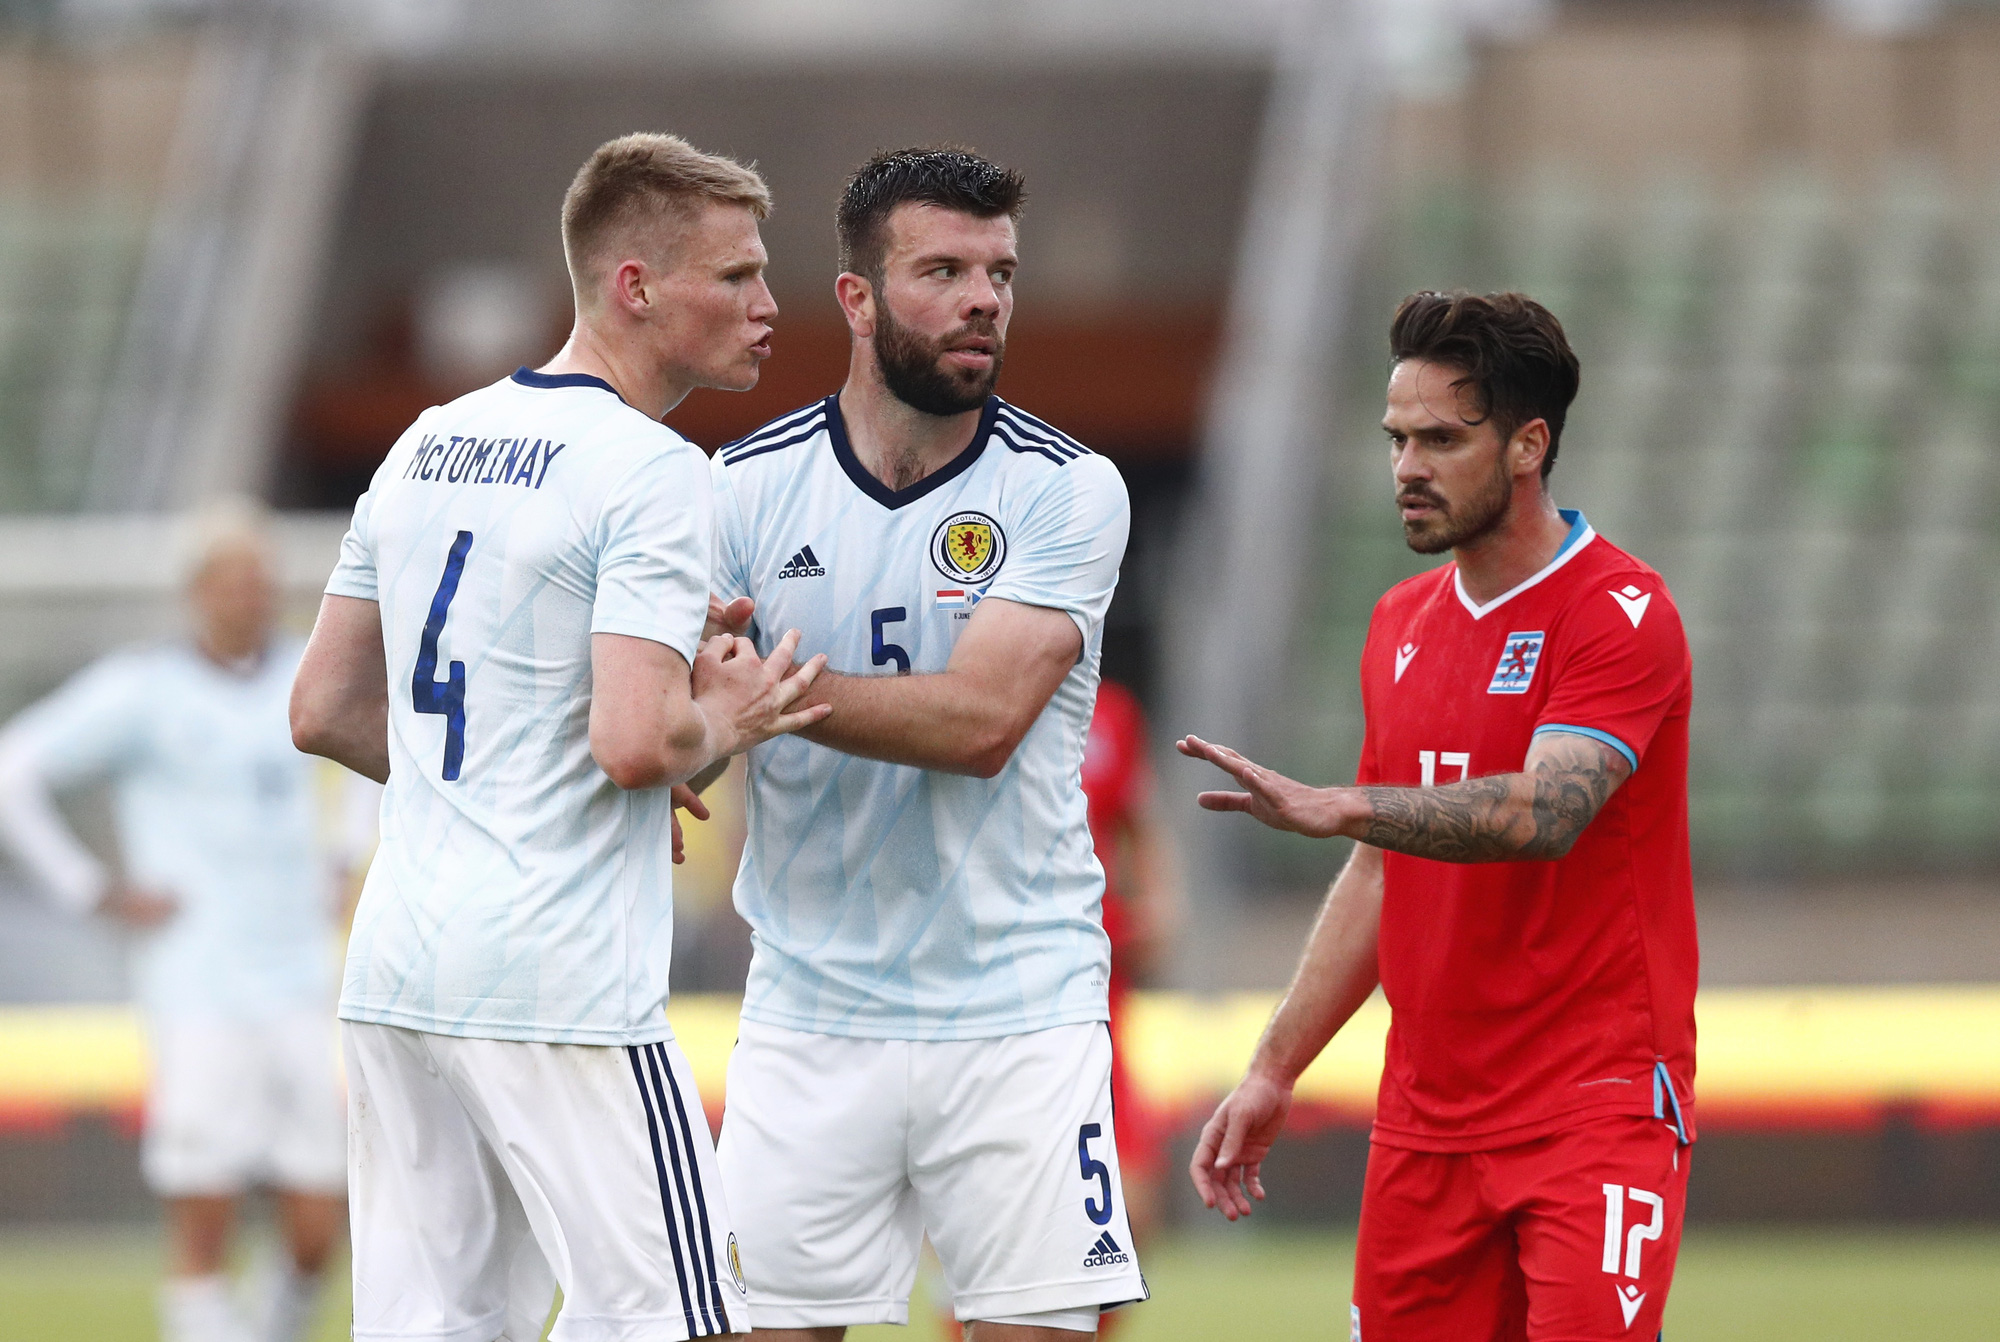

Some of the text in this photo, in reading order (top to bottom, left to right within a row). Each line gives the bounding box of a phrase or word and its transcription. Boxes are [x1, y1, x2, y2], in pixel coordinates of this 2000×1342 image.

[403, 433, 566, 489] McTOMINAY
[952, 515, 987, 524] SCOTLAND
[778, 566, 825, 579] adidas
[942, 565, 953, 575] EST
[983, 566, 995, 578] 1873
[412, 530, 473, 781] 4
[871, 606, 911, 677] 5
[1078, 1123, 1112, 1225] 5
[1602, 1183, 1664, 1280] 17
[1083, 1253, 1129, 1267] adidas
